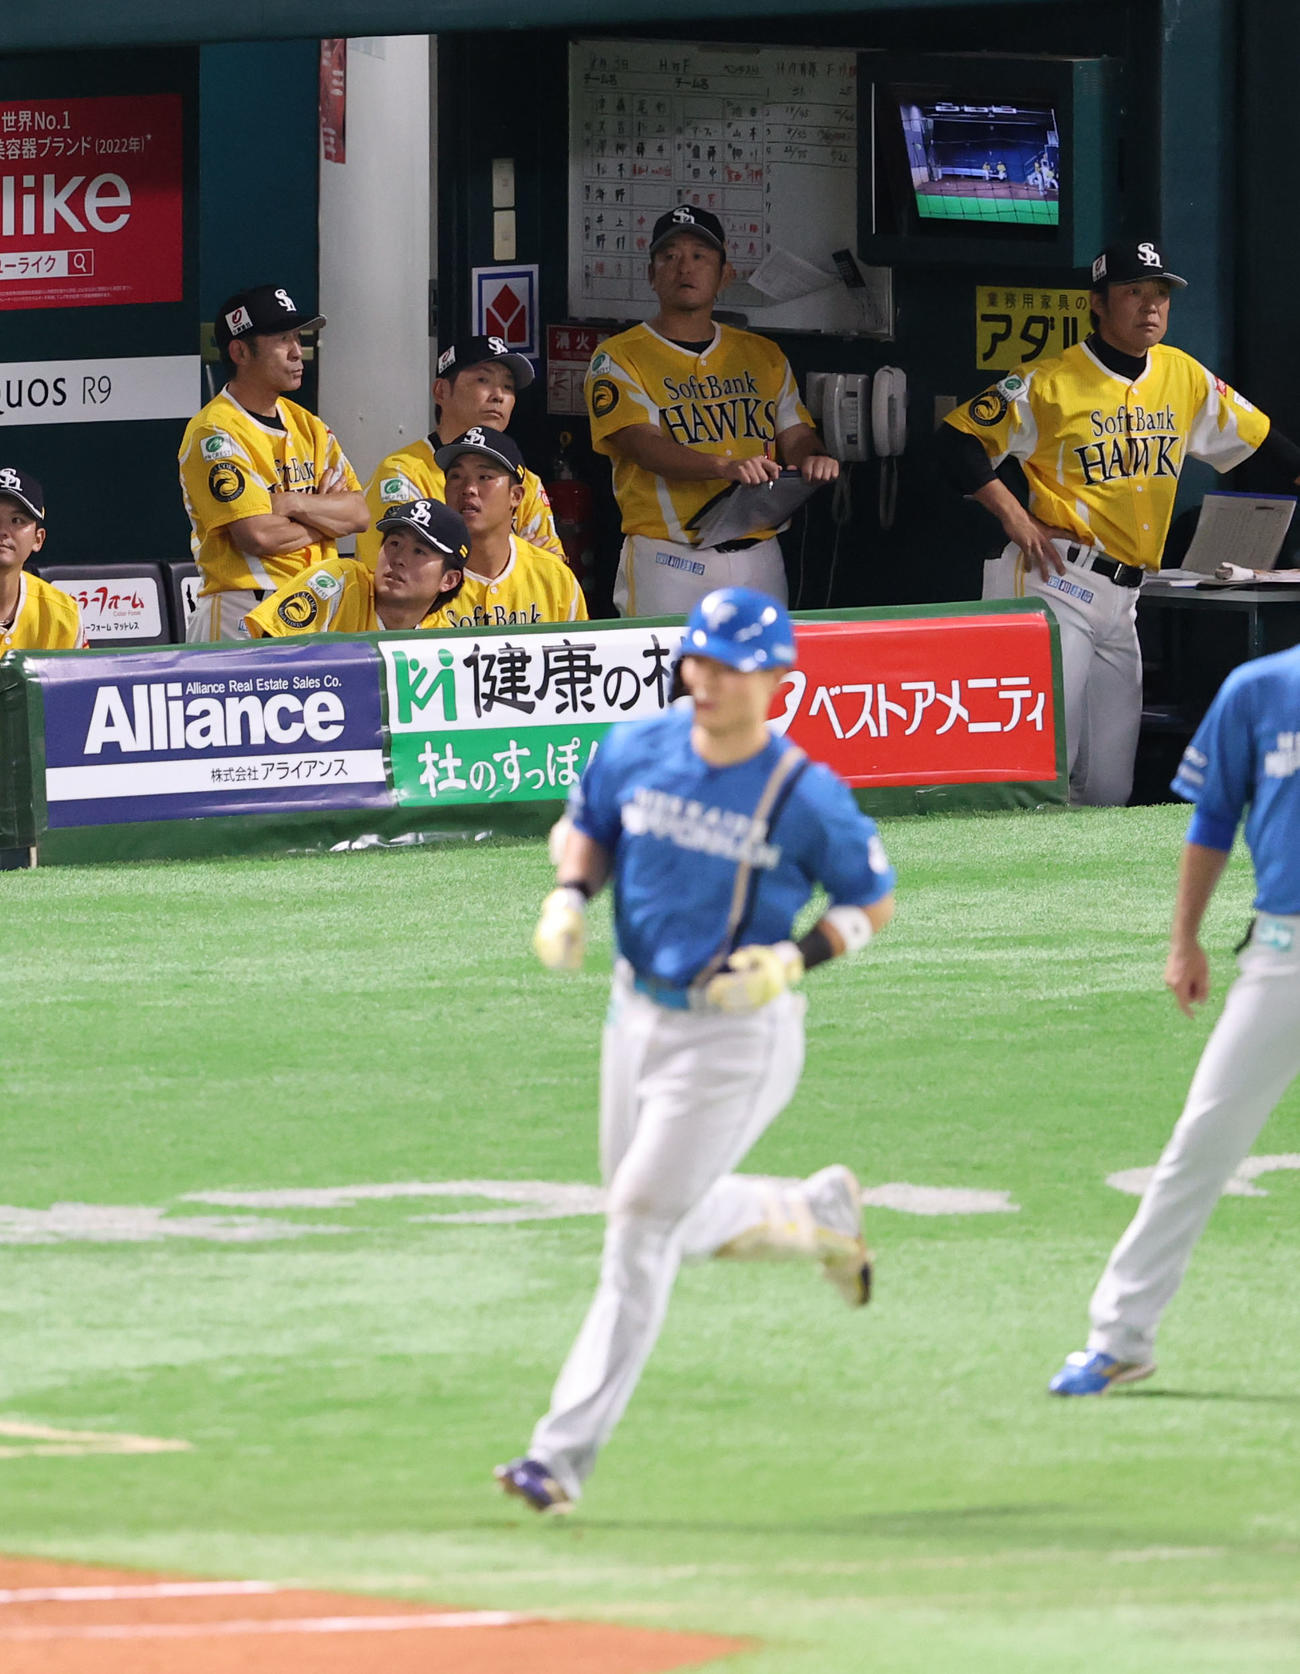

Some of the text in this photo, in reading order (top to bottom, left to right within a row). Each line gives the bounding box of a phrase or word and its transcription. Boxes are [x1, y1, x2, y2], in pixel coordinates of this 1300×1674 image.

[2, 110, 71, 132] 世界No.1
[0, 255, 56, 274] ーライク
[0, 375, 112, 415] UOS R9
[662, 371, 759, 401] SoftBank
[659, 398, 777, 446] HAWKS
[1090, 404, 1176, 437] SoftBank
[185, 674, 342, 695] Alliance Real Estate Sales Co.
[83, 682, 346, 756] Alliance
[808, 676, 1046, 740] ベストアメニティ
